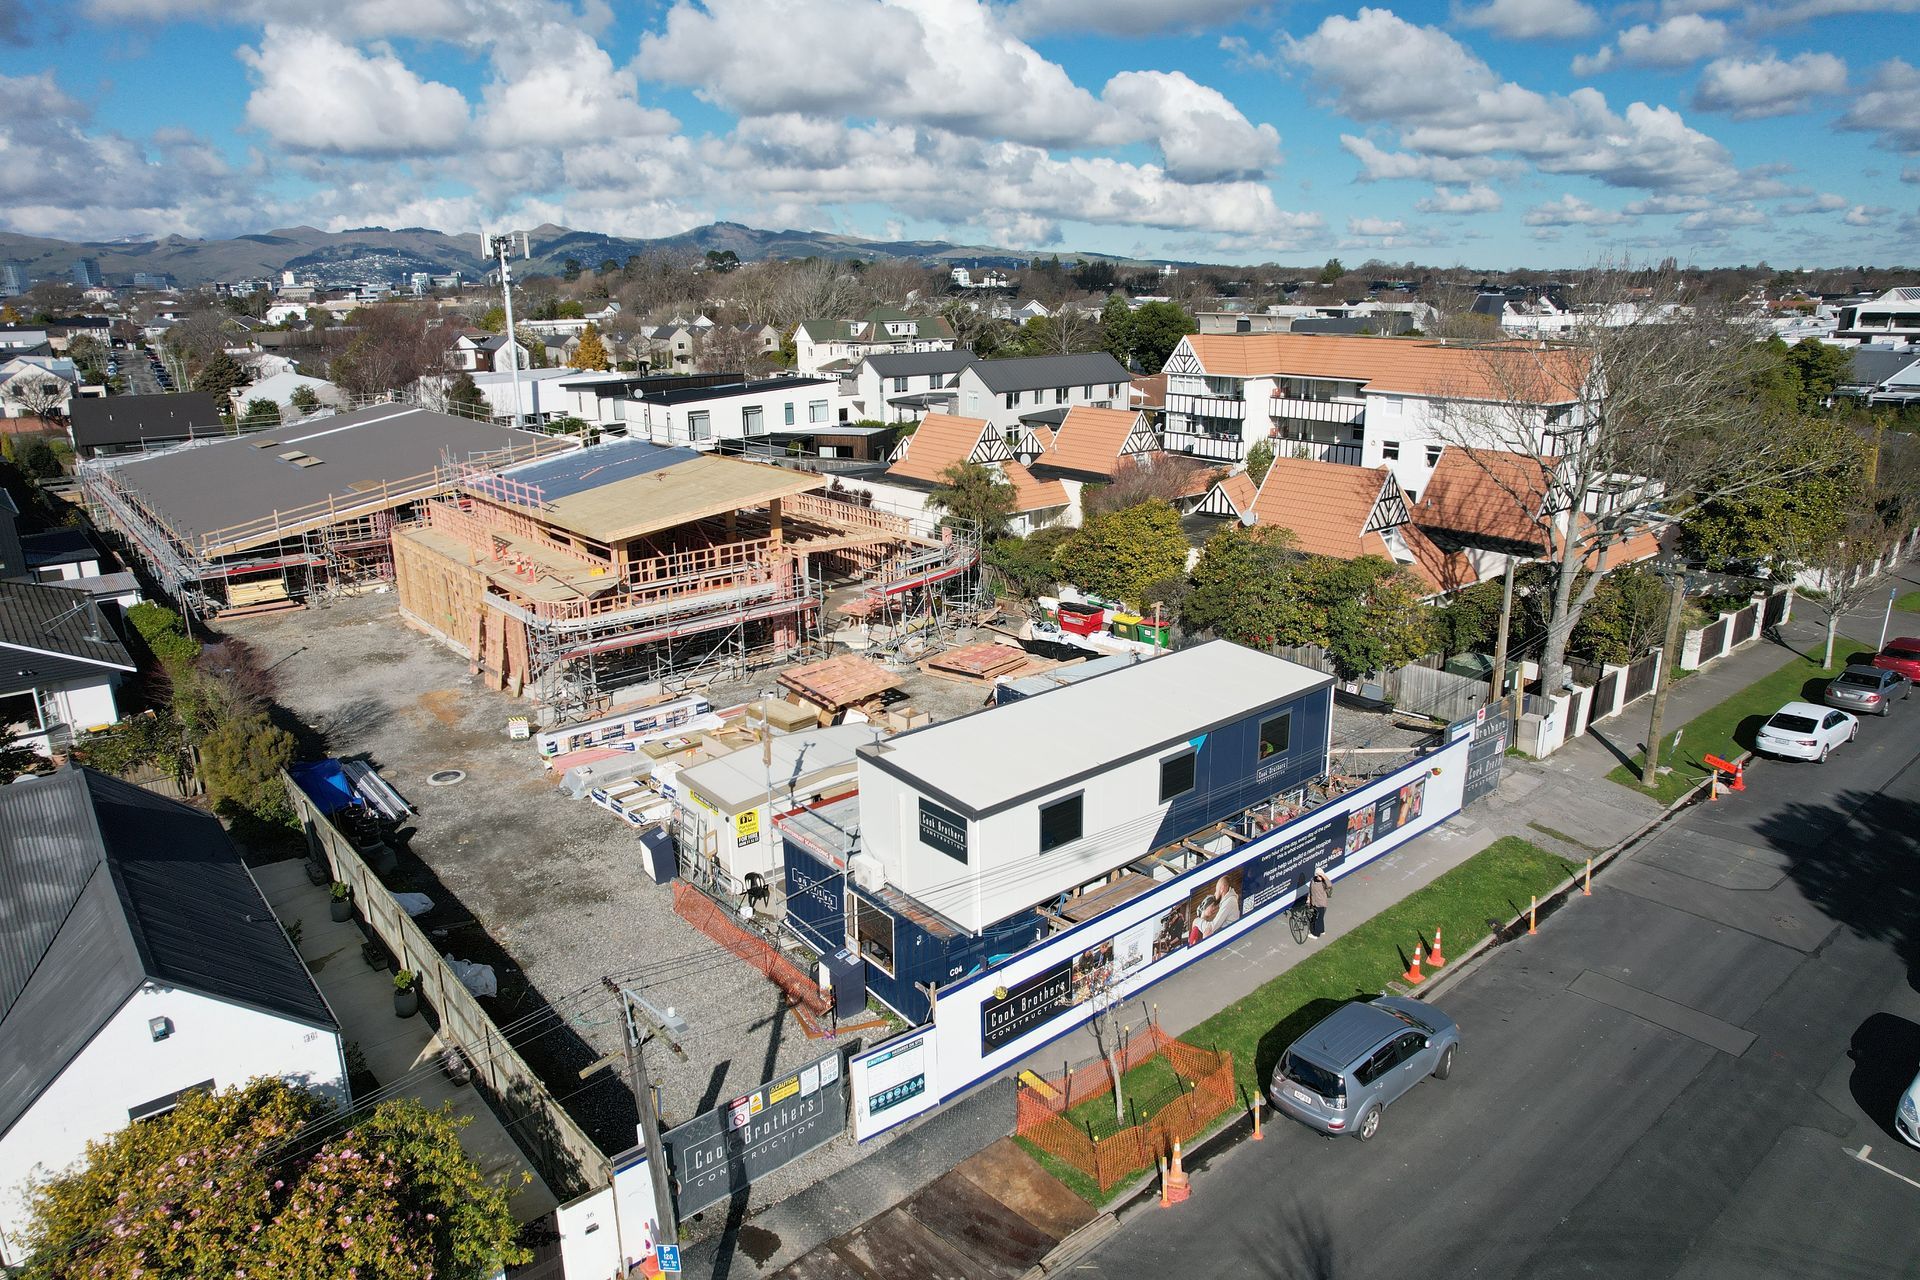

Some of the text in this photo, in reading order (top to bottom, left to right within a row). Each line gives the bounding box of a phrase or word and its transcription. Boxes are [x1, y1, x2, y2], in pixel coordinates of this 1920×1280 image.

[922, 813, 964, 843] Cook Brothers
[949, 965, 963, 977] C04
[991, 980, 1065, 1027] Cook Brothers
[773, 1074, 798, 1092] CAUTION
[695, 1099, 815, 1169] Cook Brothers
[697, 1120, 816, 1188] CONSTRUCTION
[663, 1253, 674, 1261] 120
[664, 1246, 671, 1254] P
